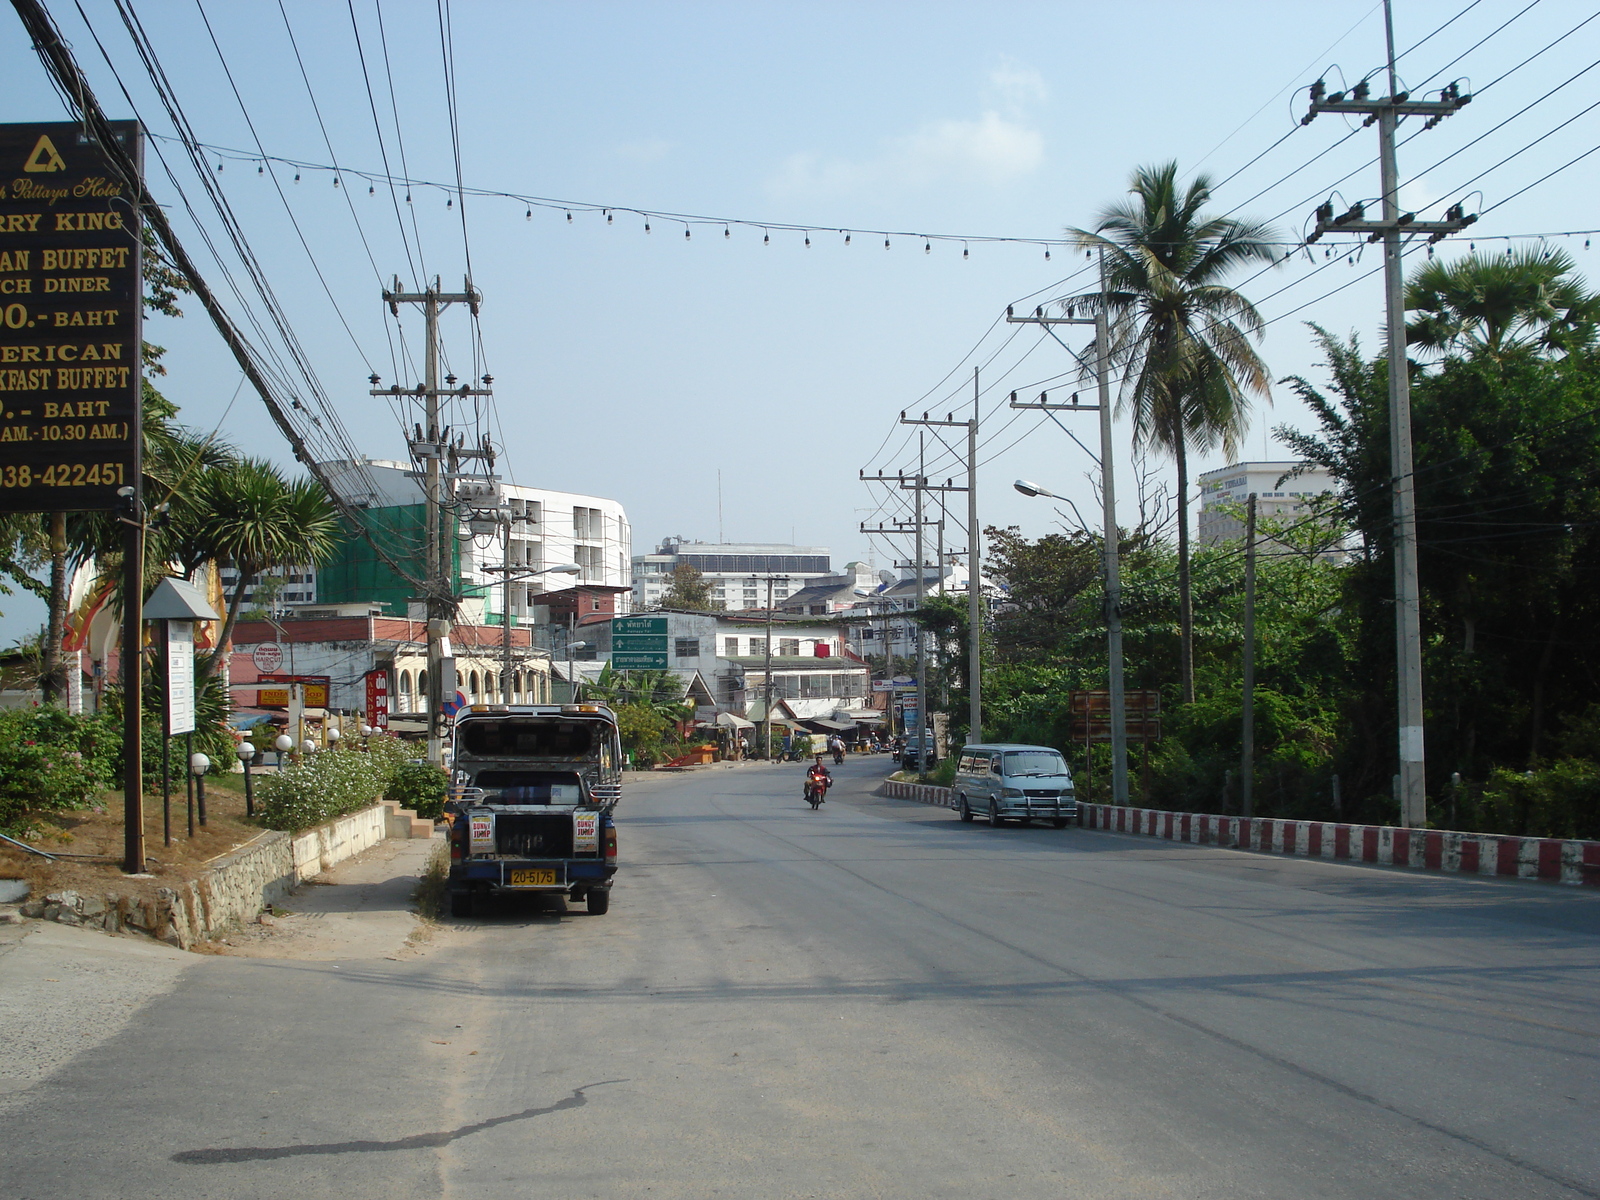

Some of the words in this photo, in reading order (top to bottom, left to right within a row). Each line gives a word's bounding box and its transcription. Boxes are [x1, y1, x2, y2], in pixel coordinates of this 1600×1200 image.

[12, 178, 69, 206] Pattaya
[55, 211, 123, 231] KING
[0, 250, 30, 272] AN
[41, 247, 129, 270] BUFFET
[0, 278, 32, 294] CH
[44, 277, 110, 293] DINER
[0, 303, 48, 329] 0.-
[54, 309, 119, 327] BAHT
[0, 343, 122, 362] ERICAN
[56, 366, 129, 390] BUFFET
[44, 400, 110, 418] BAHT
[89, 422, 128, 441] AM.)
[0, 463, 124, 488] 38-422451
[375, 695, 387, 708] อบ
[473, 830, 491, 838] JUMP
[577, 828, 595, 836] JUMP
[513, 871, 553, 884] 20-5175
